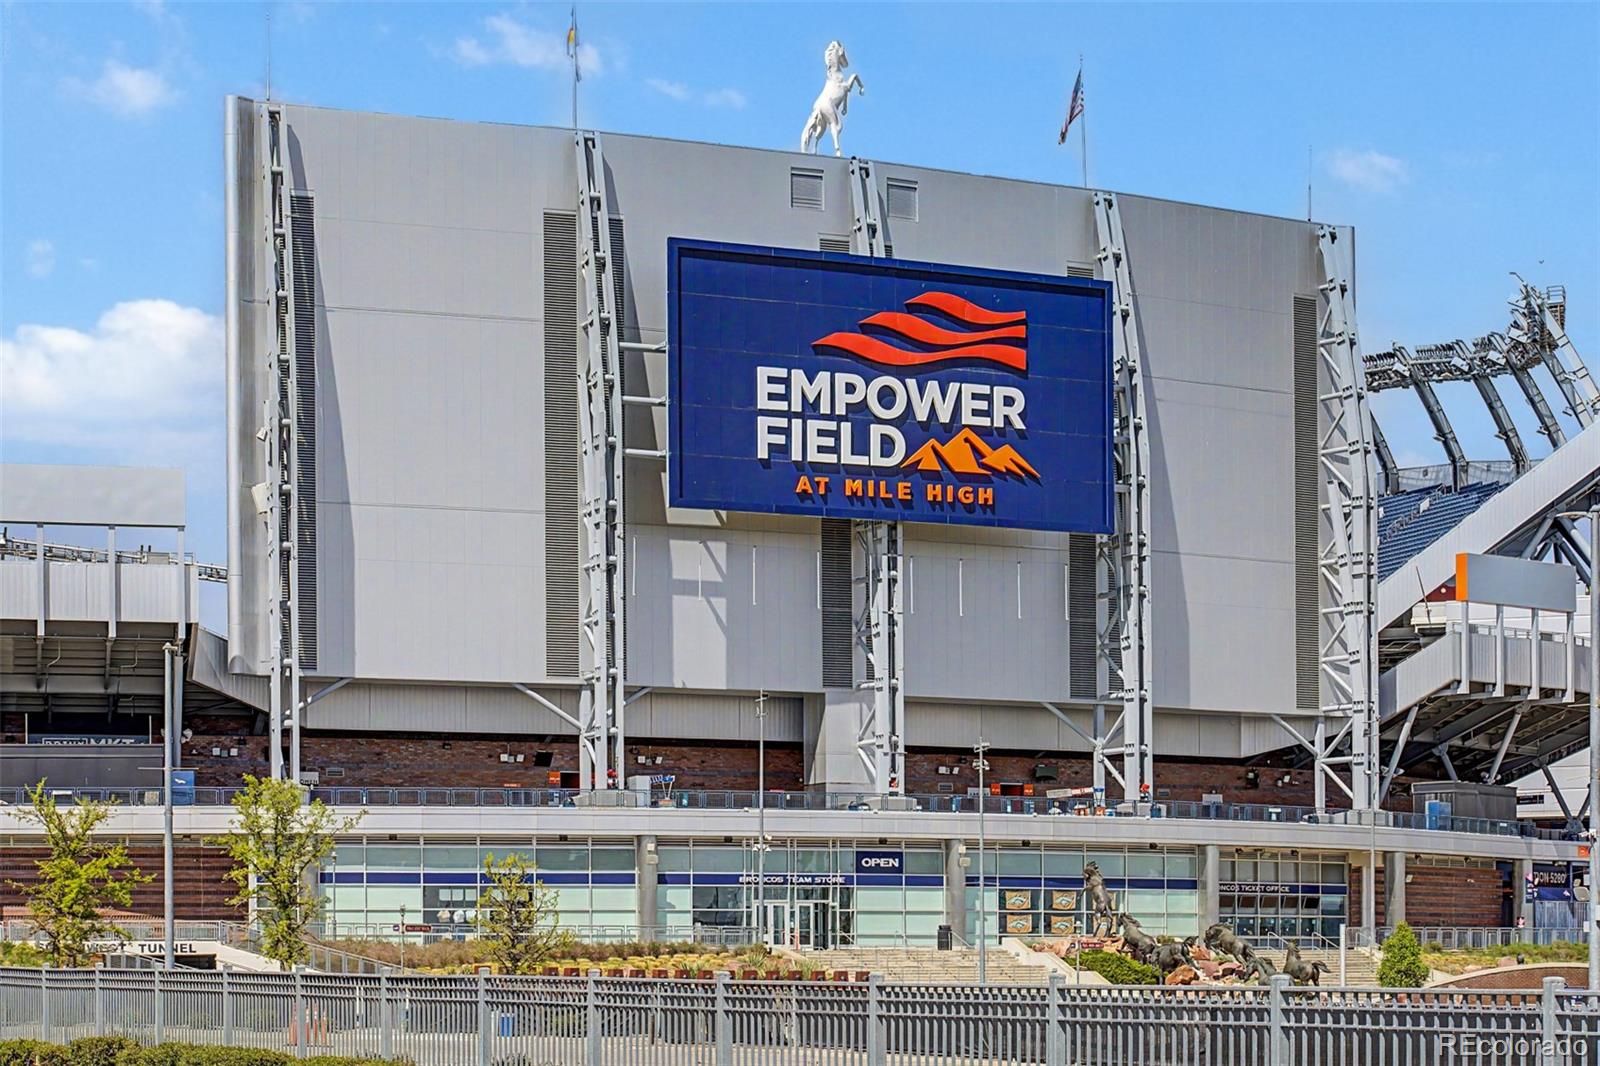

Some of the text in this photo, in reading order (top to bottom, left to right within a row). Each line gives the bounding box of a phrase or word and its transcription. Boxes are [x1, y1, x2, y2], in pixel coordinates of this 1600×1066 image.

[757, 366, 1026, 430] EMPOWER
[757, 416, 907, 467] FIELD
[795, 475, 994, 505] AT MILE HIGH
[861, 857, 899, 867] OPEN
[814, 876, 846, 884] STORE
[1241, 884, 1265, 892] TICKET
[138, 943, 197, 954] TUNNEL
